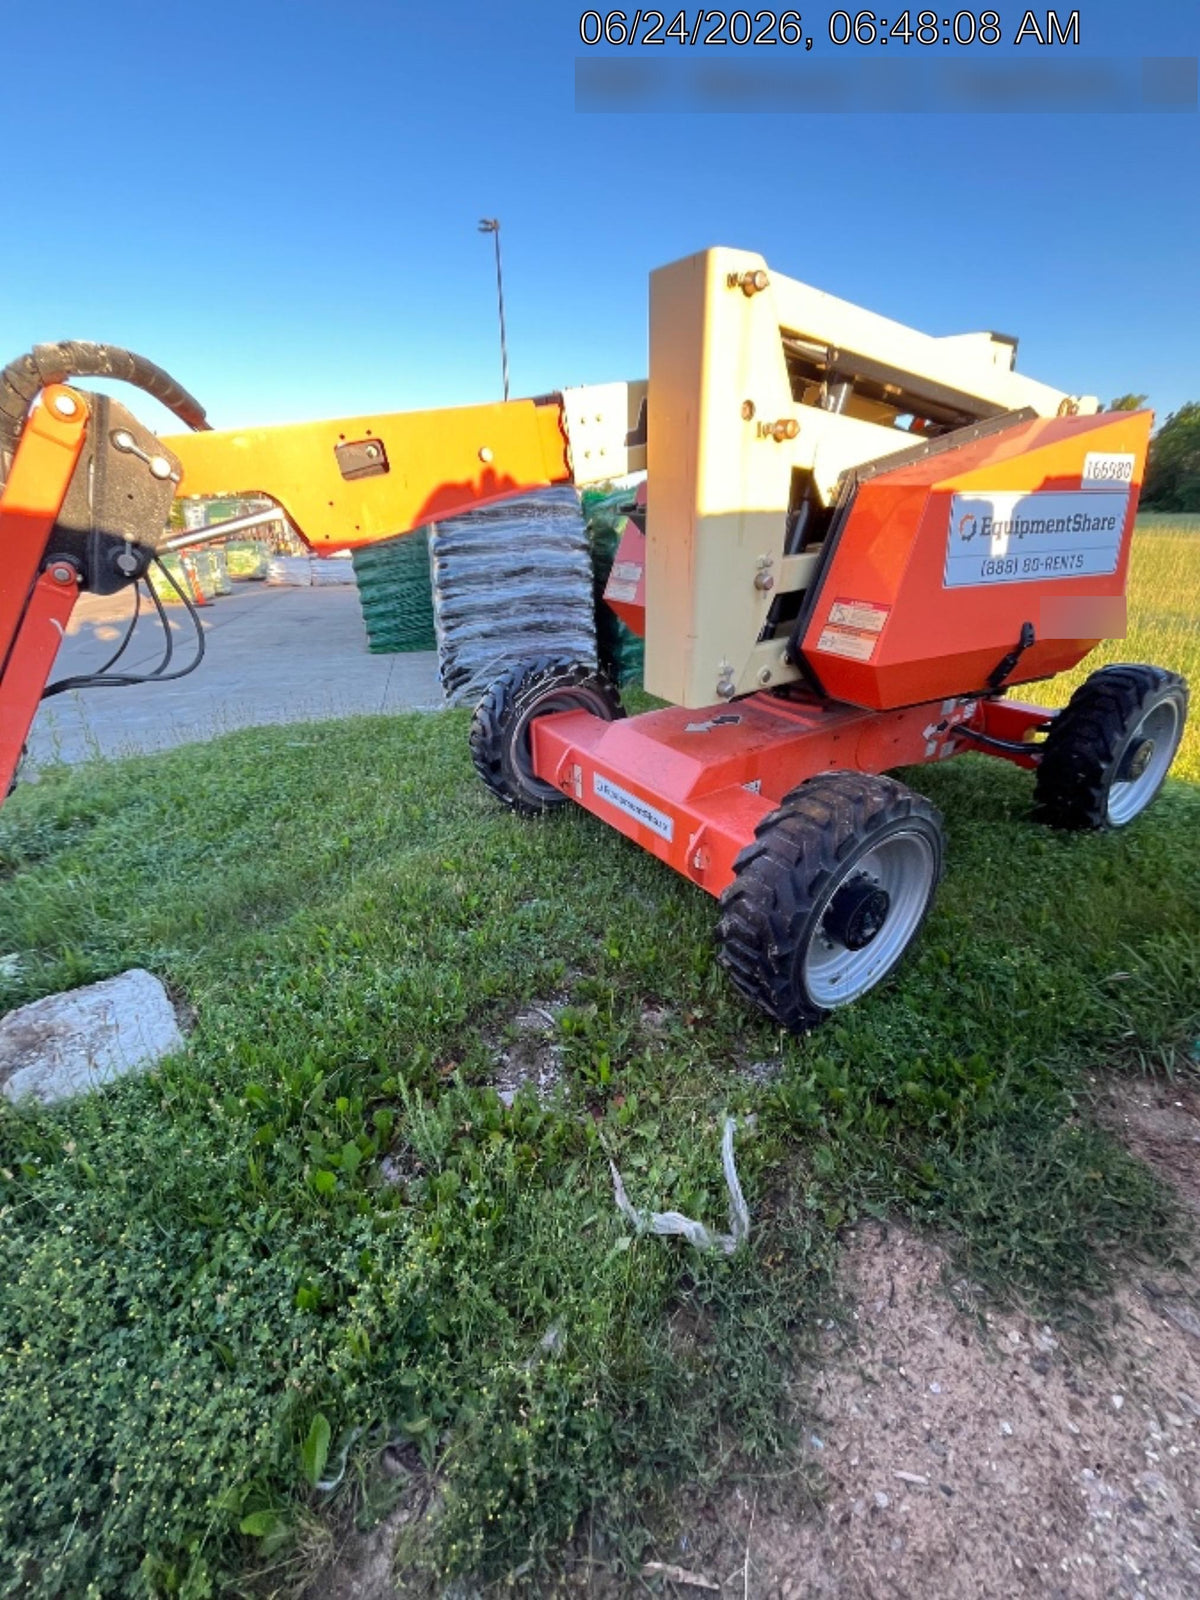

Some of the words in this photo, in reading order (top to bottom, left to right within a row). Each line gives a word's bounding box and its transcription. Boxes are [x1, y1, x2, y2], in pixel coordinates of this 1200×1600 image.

[979, 513, 1116, 539] EquipmentShare
[980, 559, 1019, 577] (888)
[1022, 554, 1084, 573] 80-RENTS
